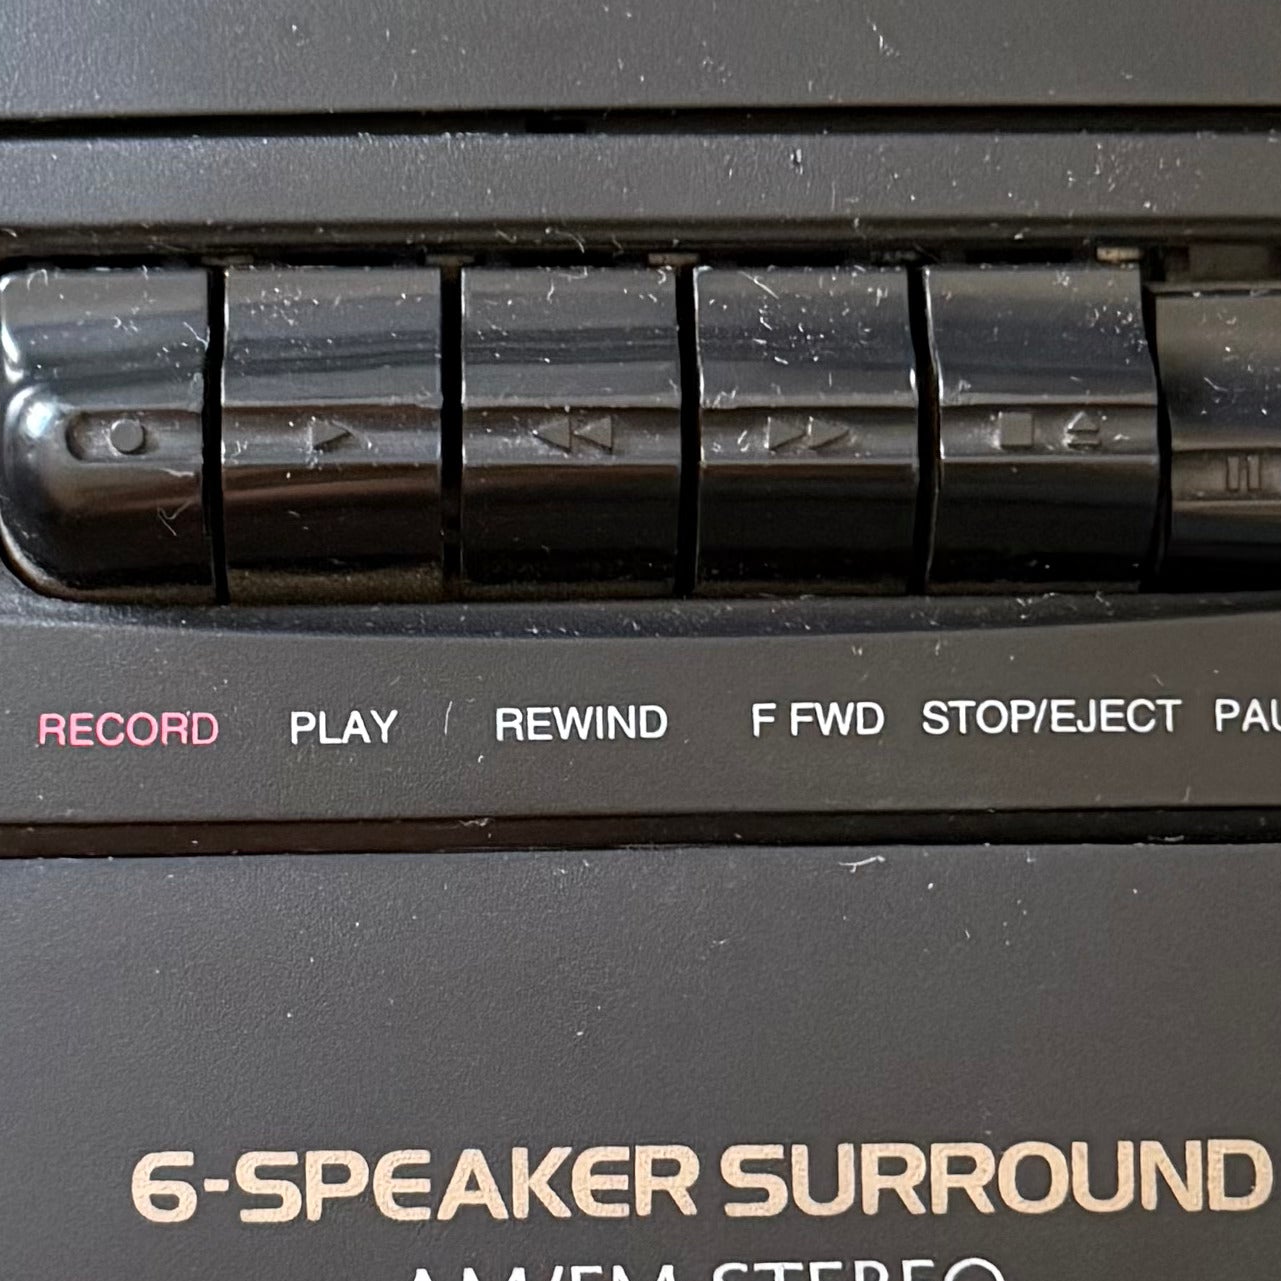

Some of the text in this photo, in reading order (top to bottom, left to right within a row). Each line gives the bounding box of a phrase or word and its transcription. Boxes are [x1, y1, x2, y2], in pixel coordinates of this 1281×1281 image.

[37, 710, 219, 746] RECORD
[289, 710, 398, 746] PLAY
[494, 706, 668, 743] REWIND
[750, 701, 886, 738] F FWD
[921, 698, 1182, 739] STOP/EJECT
[131, 1139, 1274, 1224] 6-SPEAKER SURROUND
